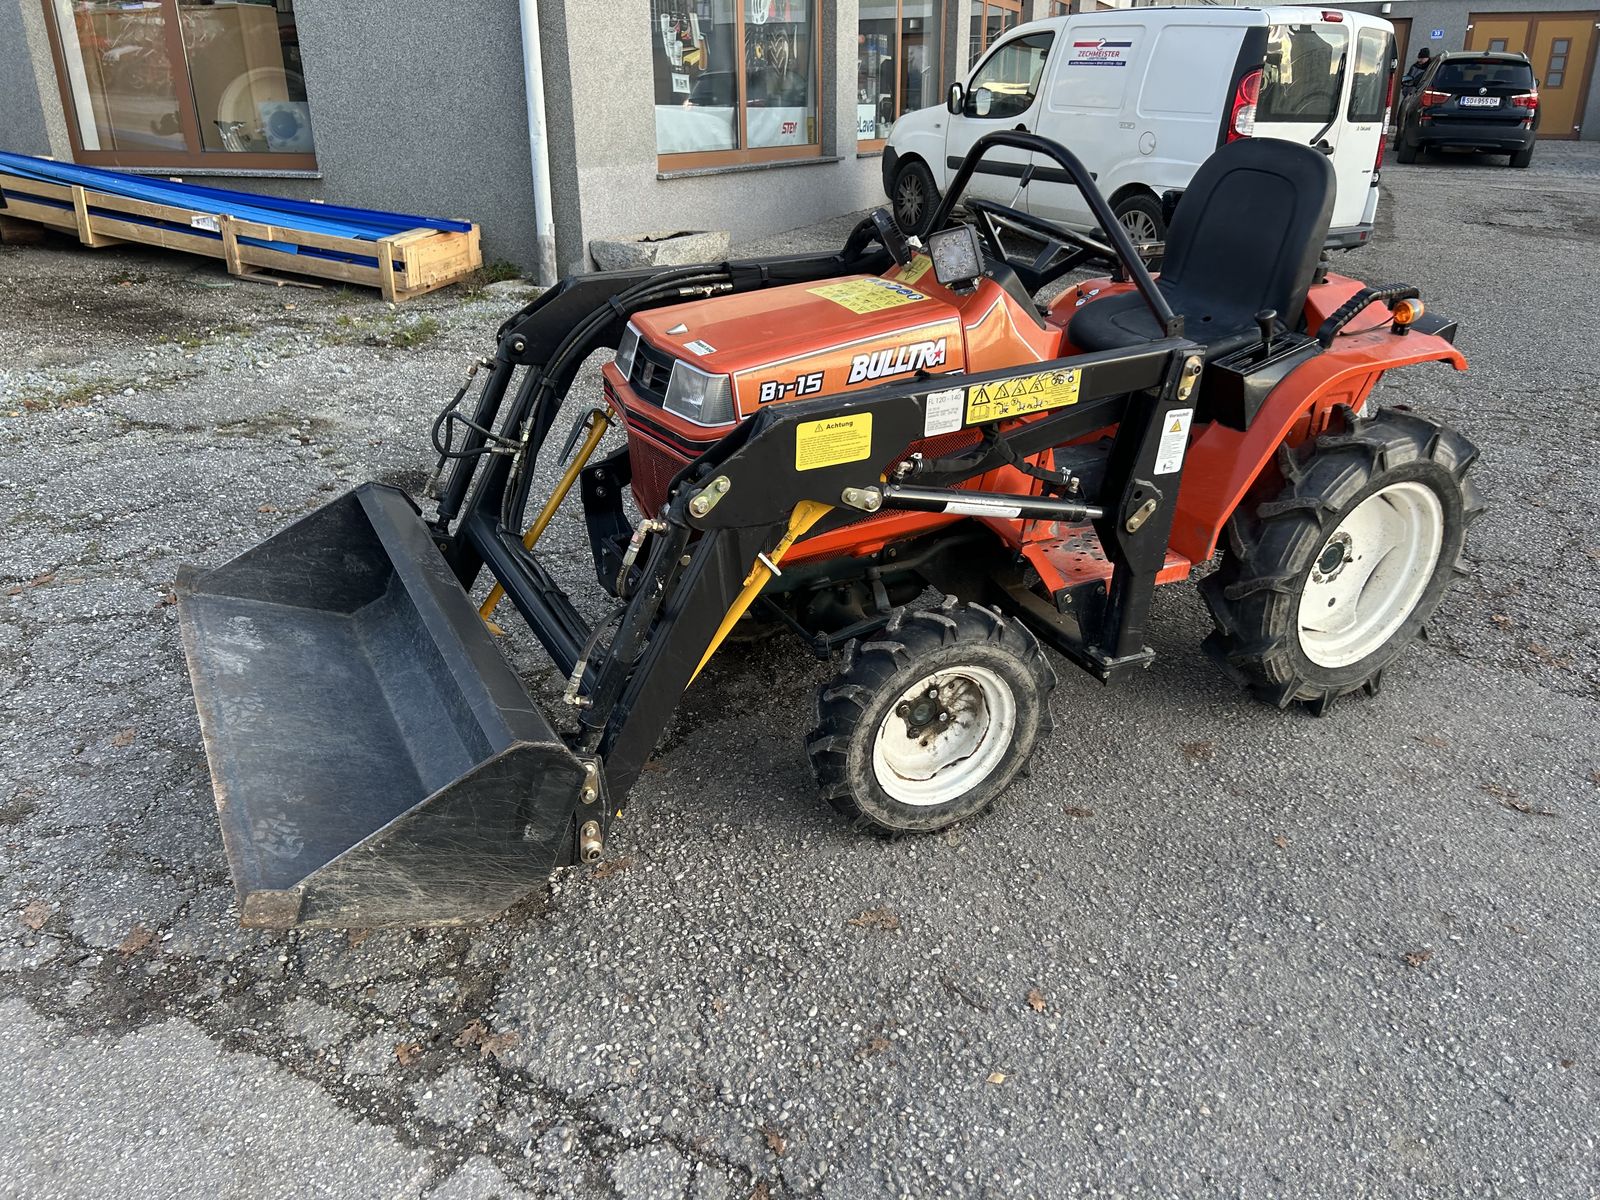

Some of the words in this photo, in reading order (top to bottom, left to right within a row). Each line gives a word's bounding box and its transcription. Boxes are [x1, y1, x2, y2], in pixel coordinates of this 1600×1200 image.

[1078, 50, 1120, 58] ZECHMEISTER
[846, 337, 947, 385] BULLTRA
[758, 370, 825, 404] B1-15
[826, 421, 854, 430] Achtung
